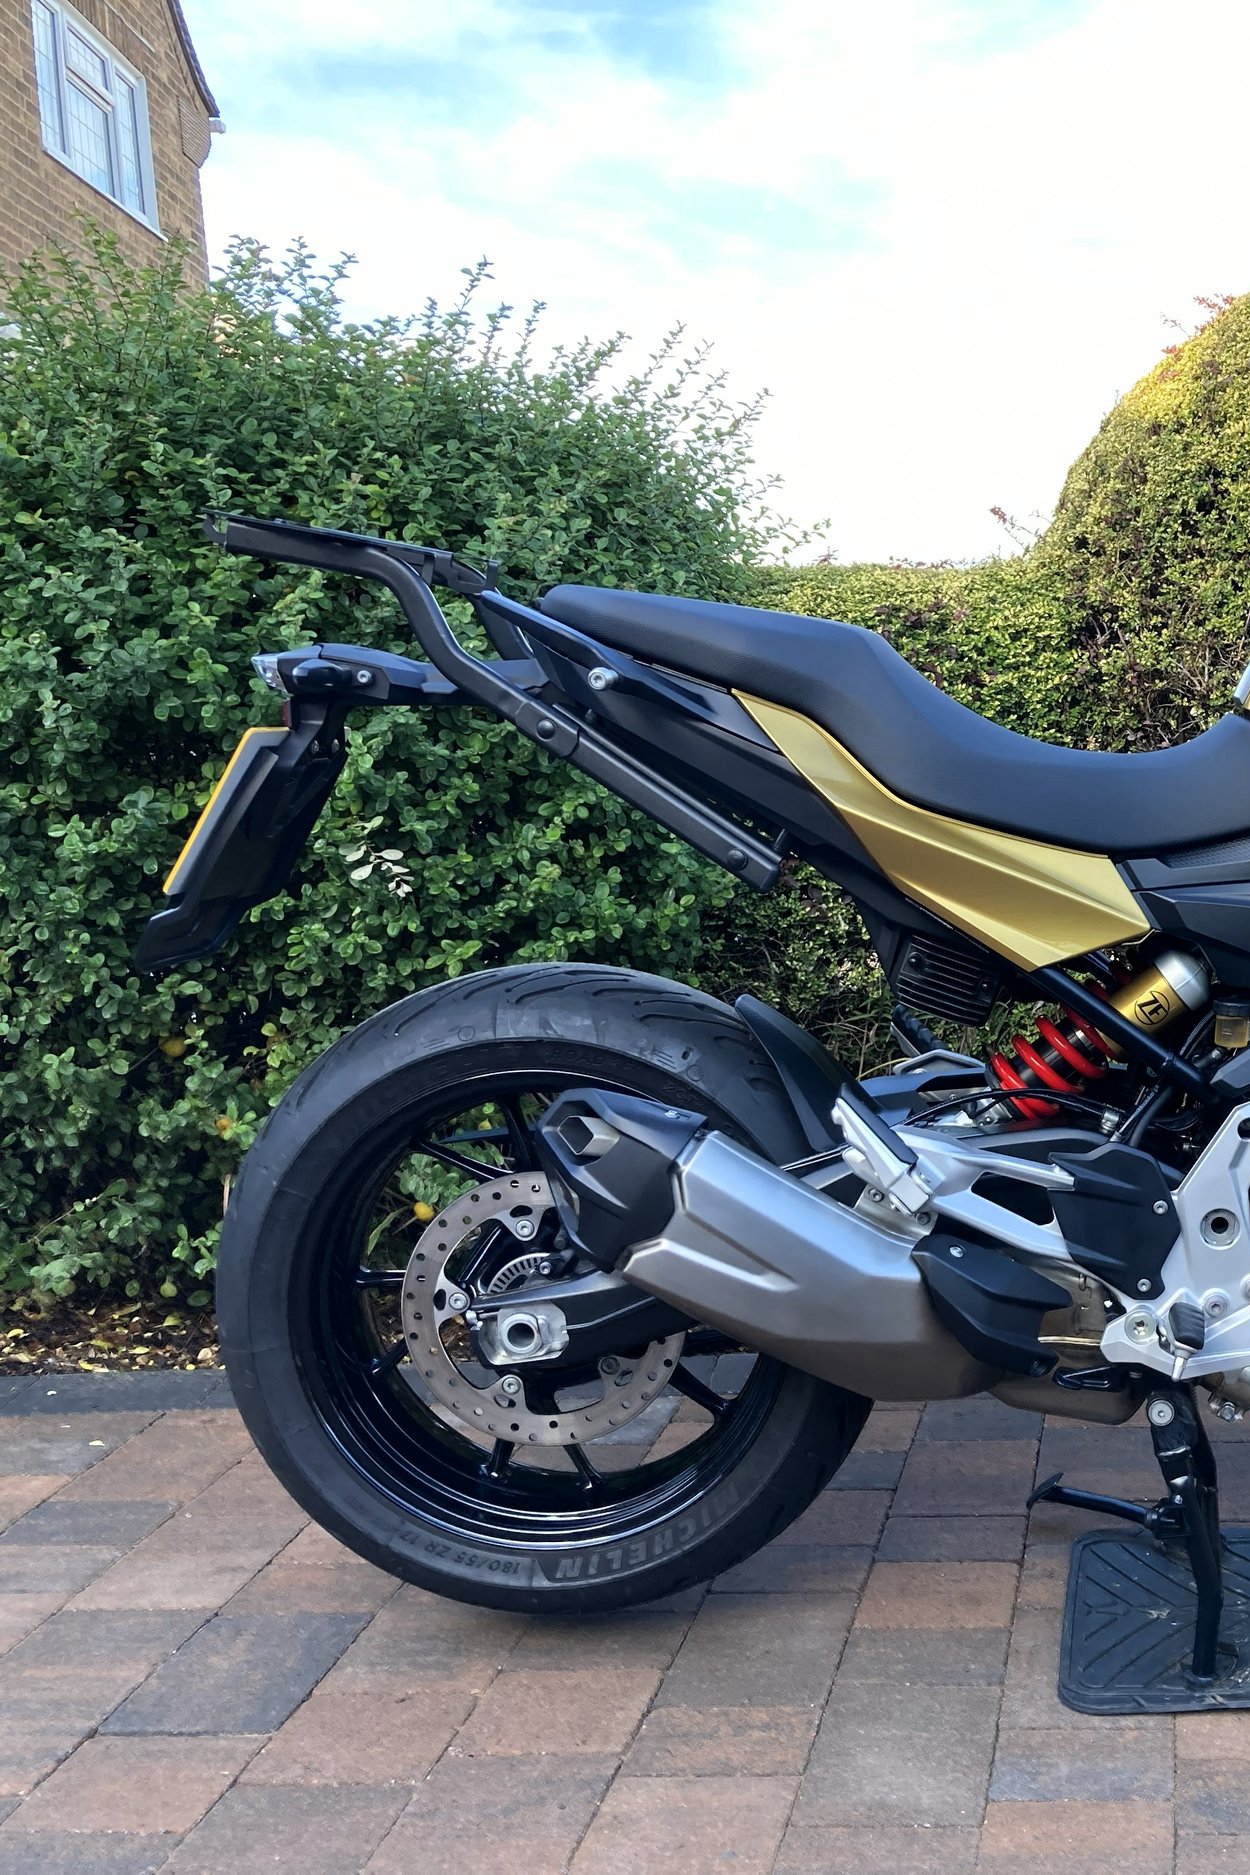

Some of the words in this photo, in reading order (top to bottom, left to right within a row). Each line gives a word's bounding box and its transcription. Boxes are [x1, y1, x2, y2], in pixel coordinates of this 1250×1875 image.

[555, 1481, 741, 1579] MICHELIN
[424, 1540, 453, 1559] ZR
[453, 1551, 521, 1575] 180/55
